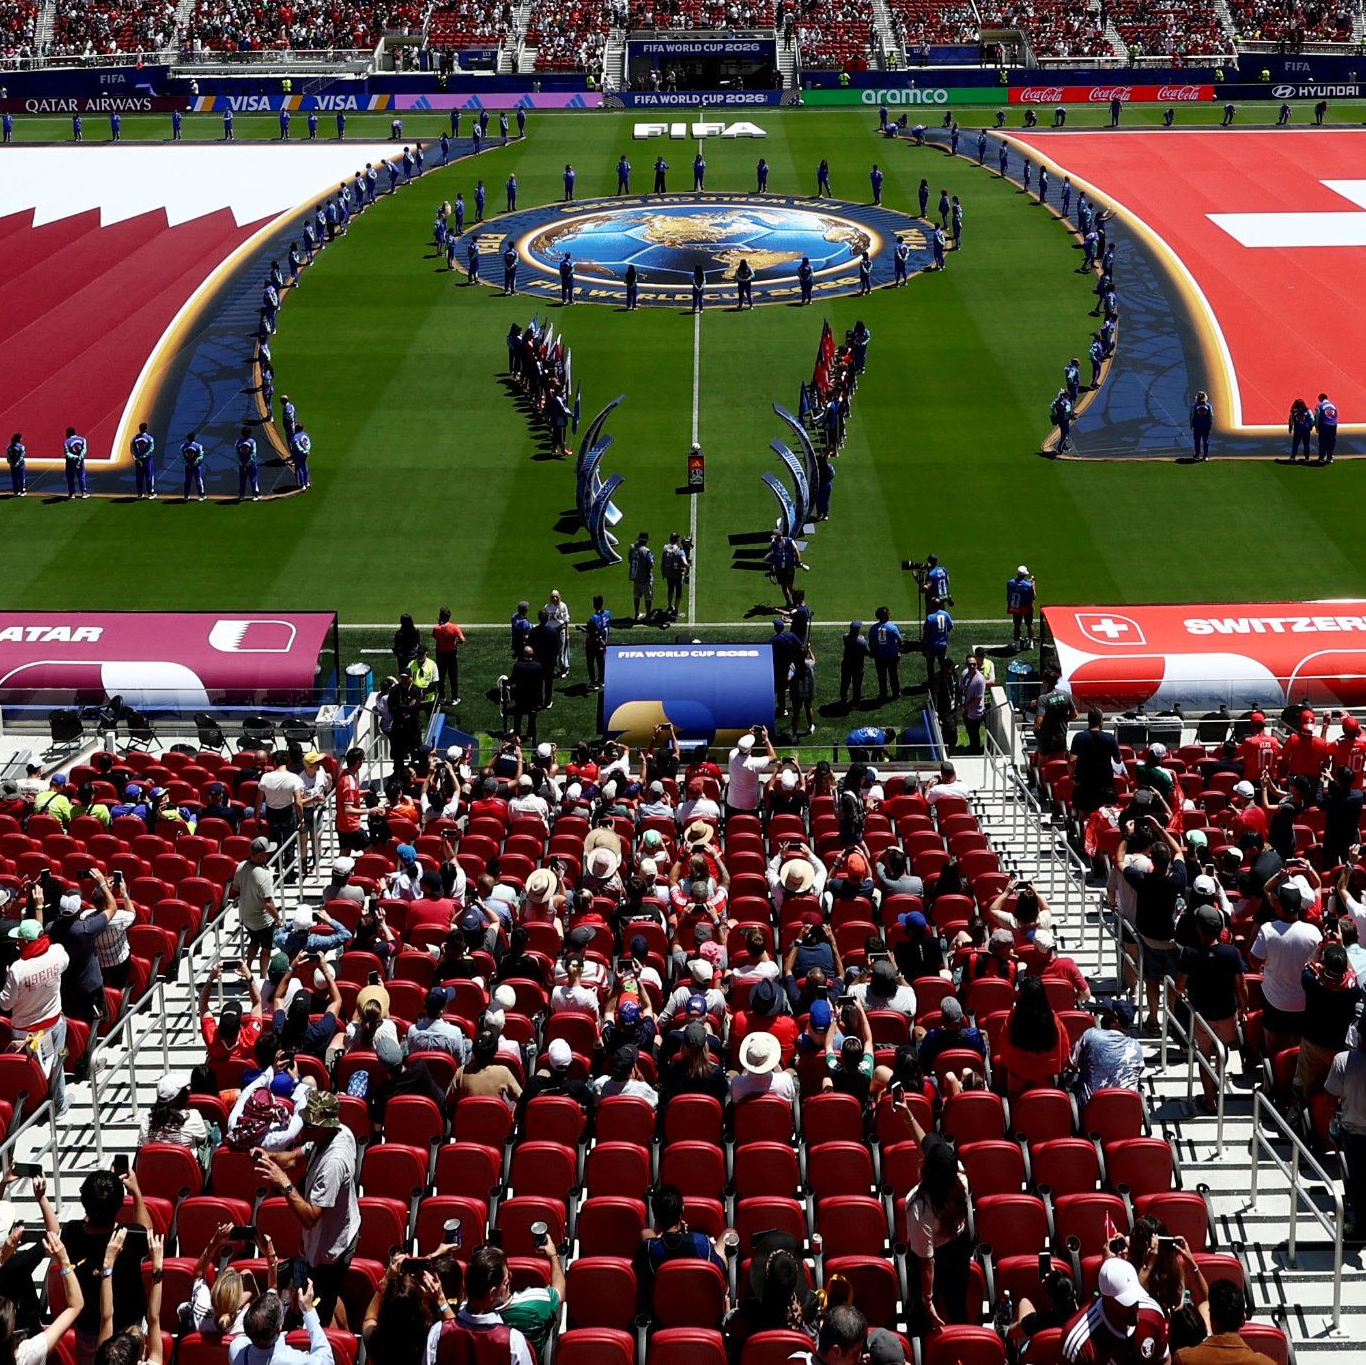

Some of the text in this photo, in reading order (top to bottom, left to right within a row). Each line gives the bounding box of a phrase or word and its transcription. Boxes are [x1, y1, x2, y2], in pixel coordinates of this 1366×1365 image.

[643, 43, 760, 53] FIFA WORLD CUP 2026
[1285, 61, 1310, 72] FIFA
[100, 74, 126, 84] FIFA
[861, 89, 948, 104] aramco
[1020, 87, 1065, 102] Coca-Cola
[1089, 86, 1133, 102] Coca-Cola
[1157, 85, 1202, 101] Coca-Cola
[1299, 85, 1360, 97] HYUNDAI
[226, 95, 271, 111] VISA
[313, 95, 358, 111] VISA
[634, 93, 764, 104] FIFA WORLD CUP 2026
[25, 98, 152, 113] QATAR AIRWAYS
[633, 122, 768, 139] FIFA
[647, 196, 696, 204] CUP
[700, 196, 787, 204] WORLD
[793, 199, 843, 211] FIFA
[589, 289, 694, 301] WORLD
[618, 650, 759, 659] FIFA WORLD CUP 2026
[24, 963, 60, 992] 49ERS
